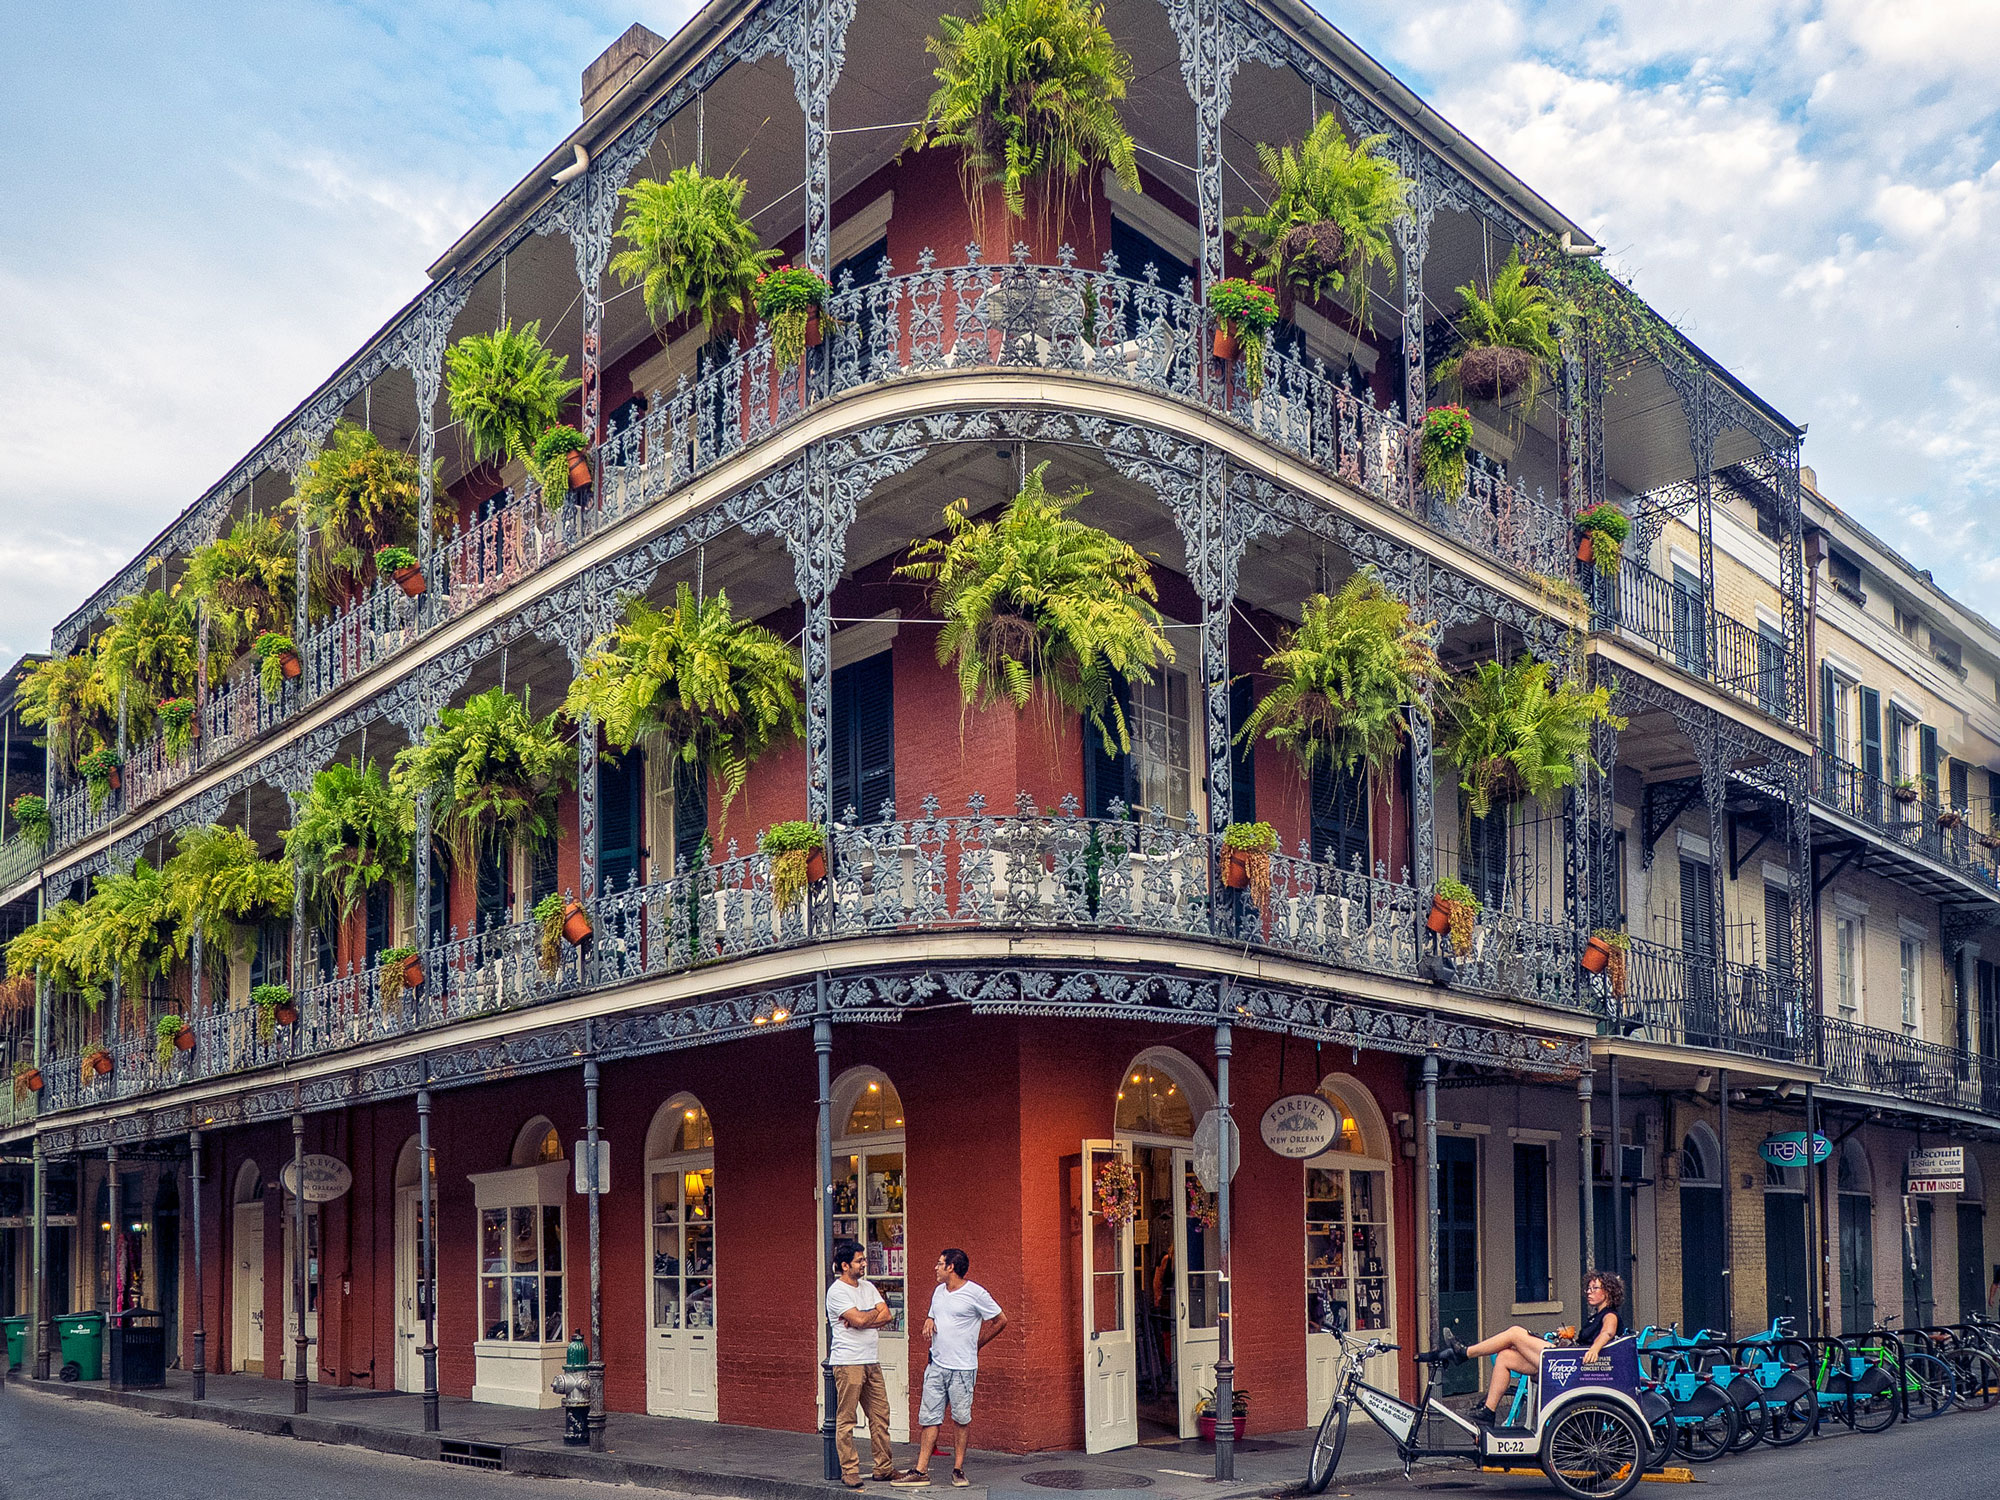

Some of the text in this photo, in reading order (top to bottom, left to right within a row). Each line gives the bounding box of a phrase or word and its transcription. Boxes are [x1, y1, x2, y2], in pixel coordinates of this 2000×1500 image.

[1270, 1100, 1326, 1122] FOREVER
[1289, 1135, 1325, 1143] ORLEANS
[1911, 1149, 1961, 1159] Discount
[1910, 1181, 1962, 1191] ATM INSIDE
[1548, 1359, 1578, 1373] Vintage
[1497, 1441, 1524, 1452] PC-22
